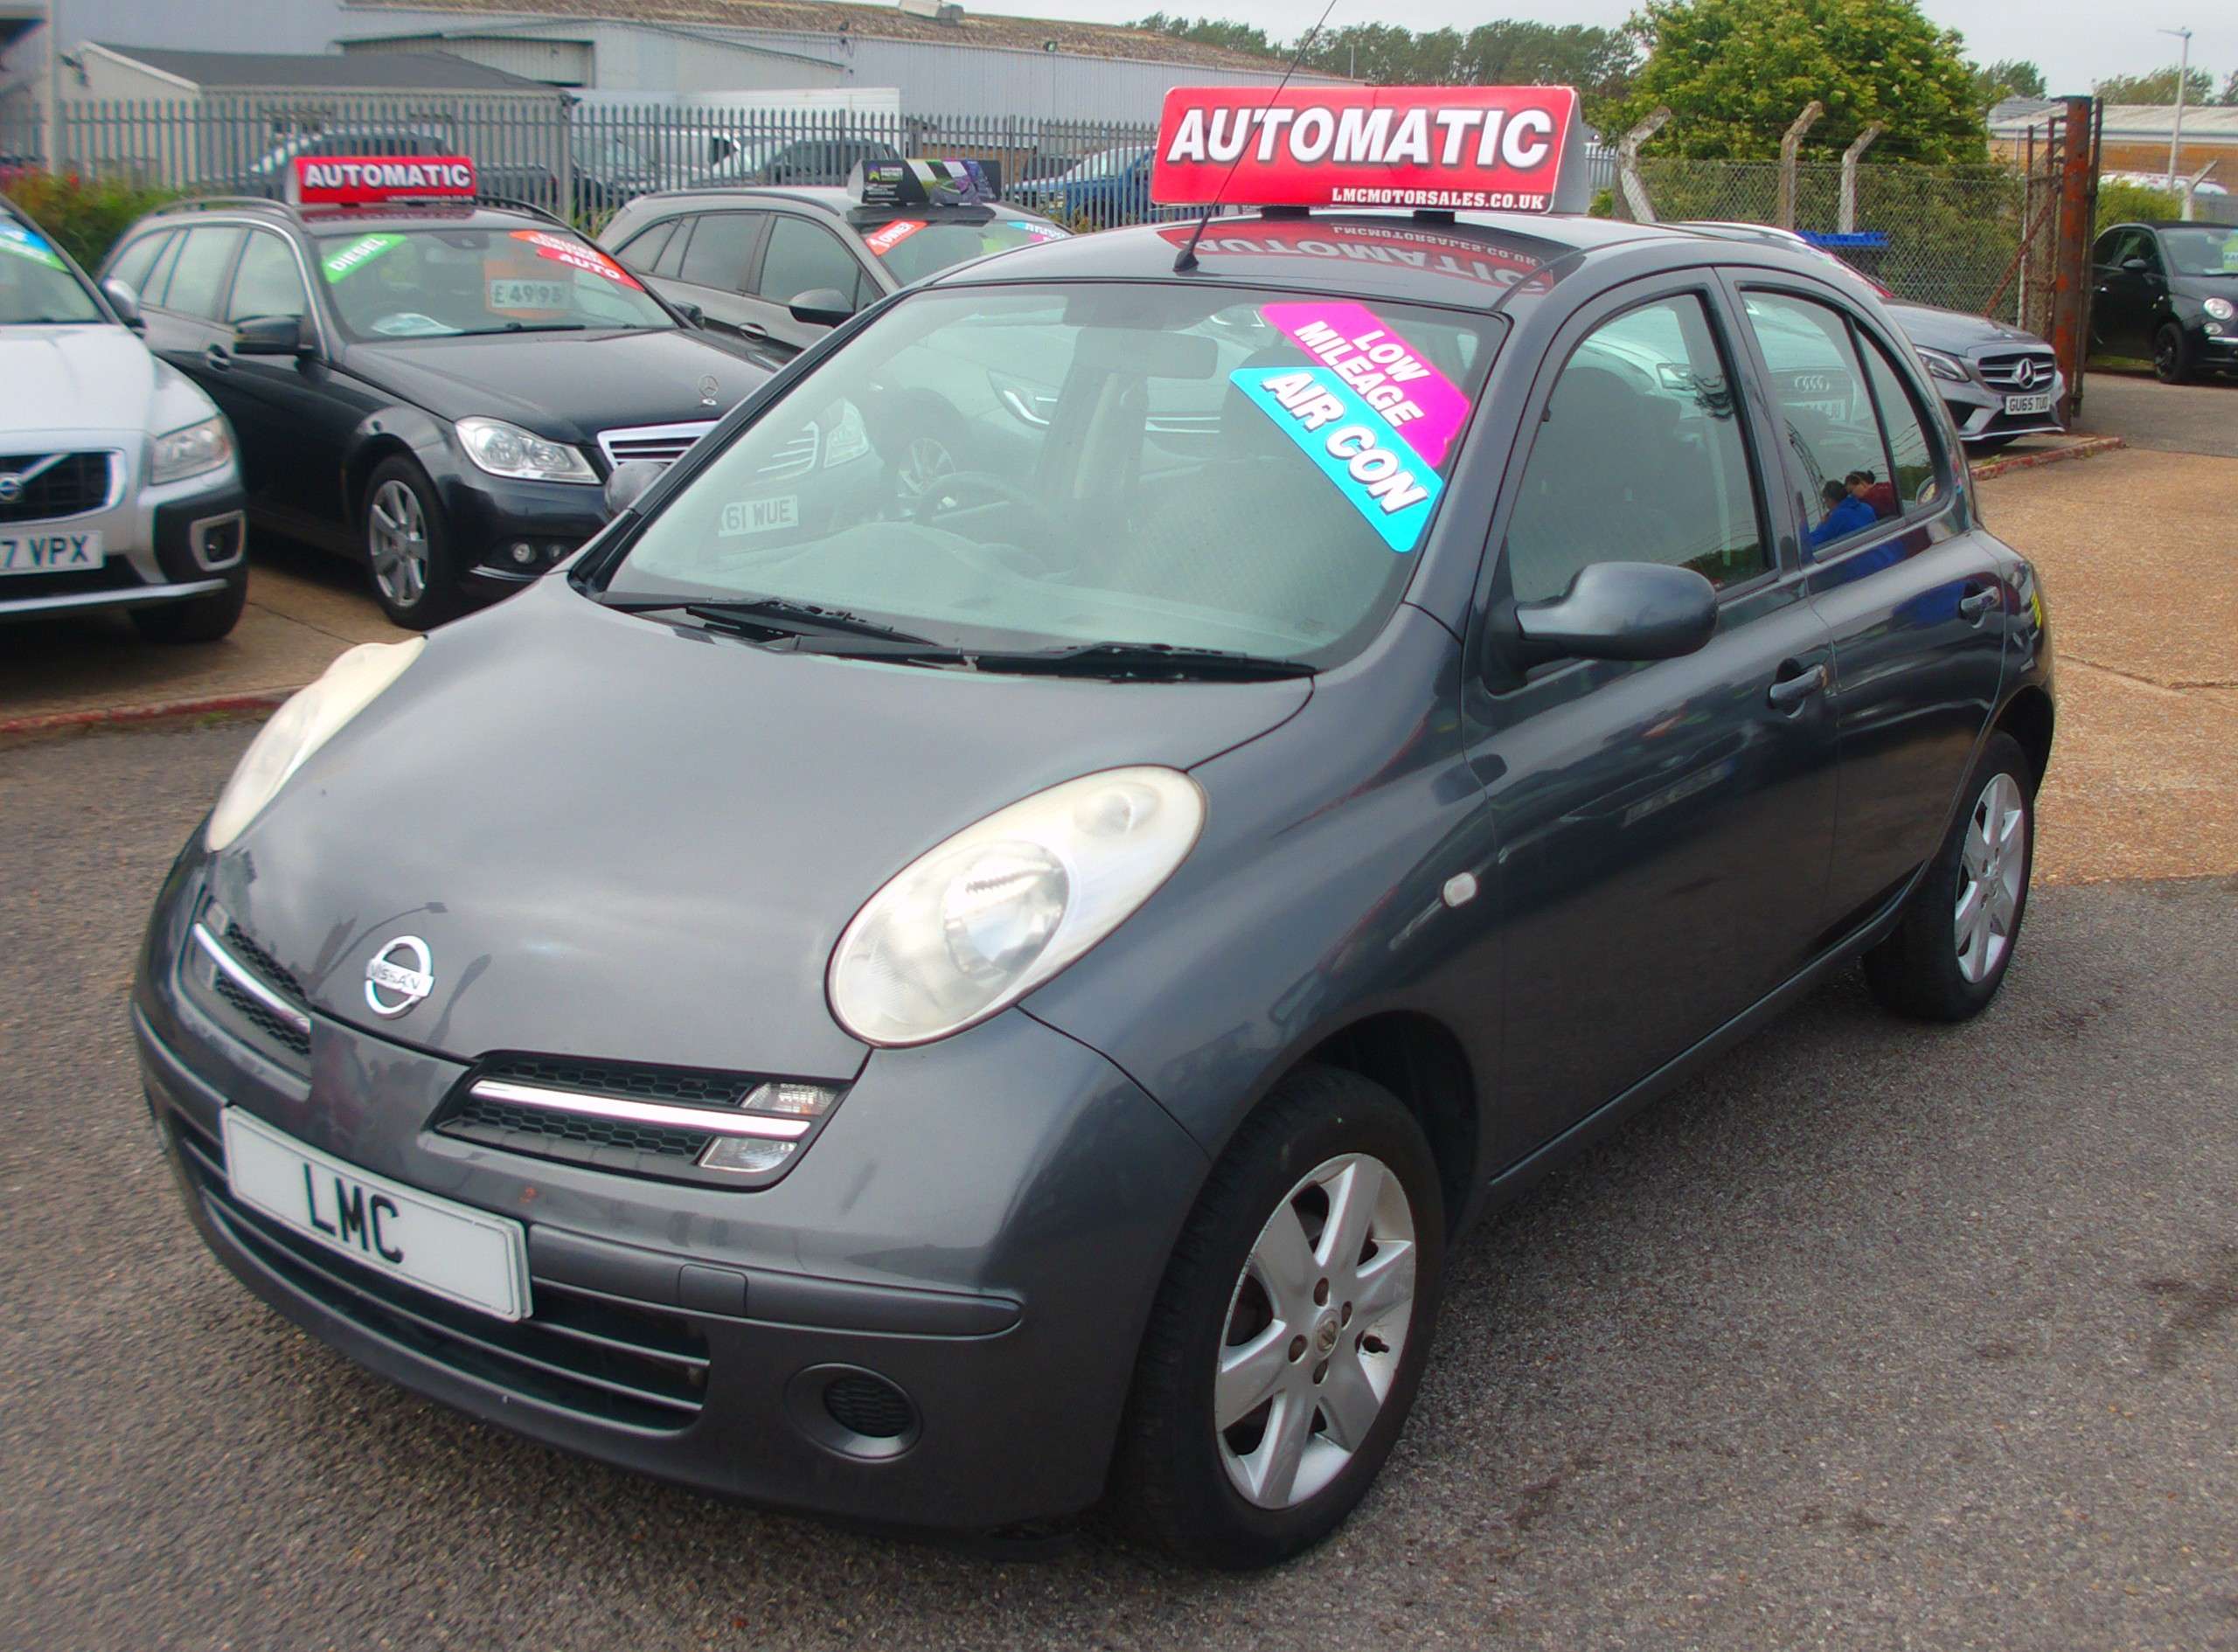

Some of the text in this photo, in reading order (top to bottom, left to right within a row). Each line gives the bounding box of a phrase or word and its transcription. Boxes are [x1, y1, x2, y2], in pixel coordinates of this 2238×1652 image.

[1166, 107, 1553, 169] AUTOMATIC
[304, 163, 472, 188] AUTOMATIC
[1331, 186, 1545, 210] LMCMOTORSALES.CO.UK
[327, 237, 388, 272] DIESEL
[560, 253, 621, 279] AUTO
[1352, 330, 1430, 382] LOW
[1293, 320, 1425, 427] MILEAGE
[2009, 397, 2033, 412] GU65
[1260, 372, 1428, 516] AIR CON
[754, 499, 791, 526] WUE
[29, 534, 89, 566] VPX
[303, 1162, 405, 1265] LMC
